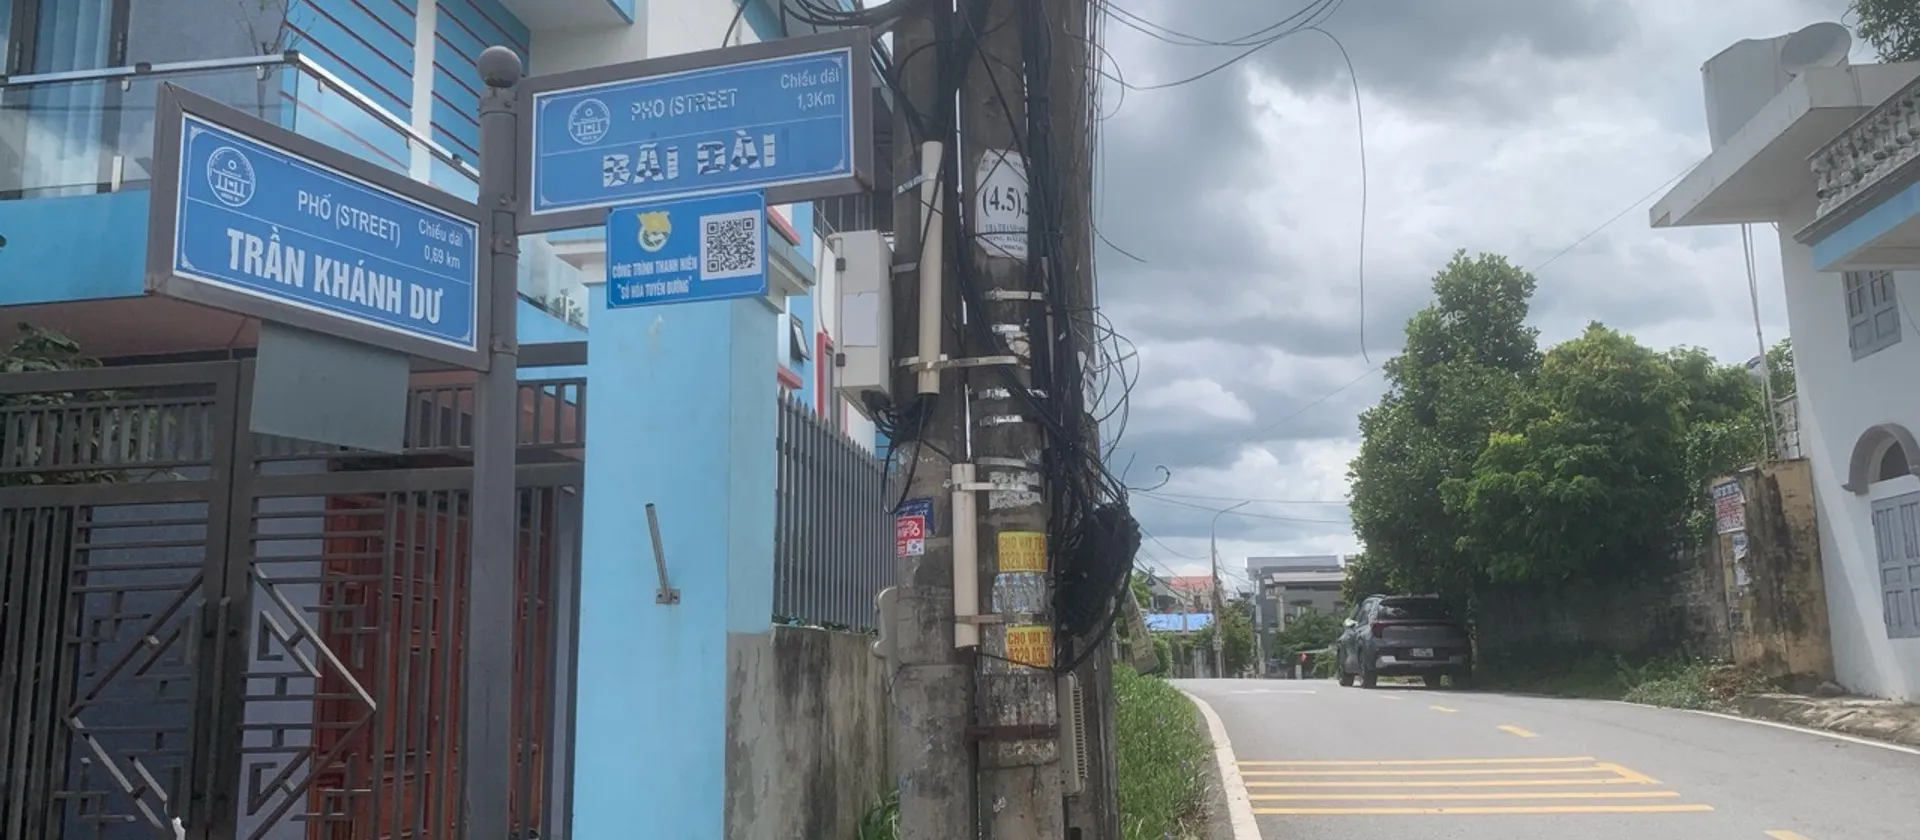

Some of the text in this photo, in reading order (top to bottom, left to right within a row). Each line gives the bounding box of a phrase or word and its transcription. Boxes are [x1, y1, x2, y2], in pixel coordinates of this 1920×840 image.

[797, 91, 836, 112] 1,3Km
[697, 129, 776, 176] DÀI
[298, 189, 400, 249] PHỐ (STREET)
[446, 251, 461, 269] km
[655, 258, 679, 274] THANH
[227, 226, 444, 325] TRẦN KHÁNH DƯ
[1007, 631, 1026, 645] CHO
